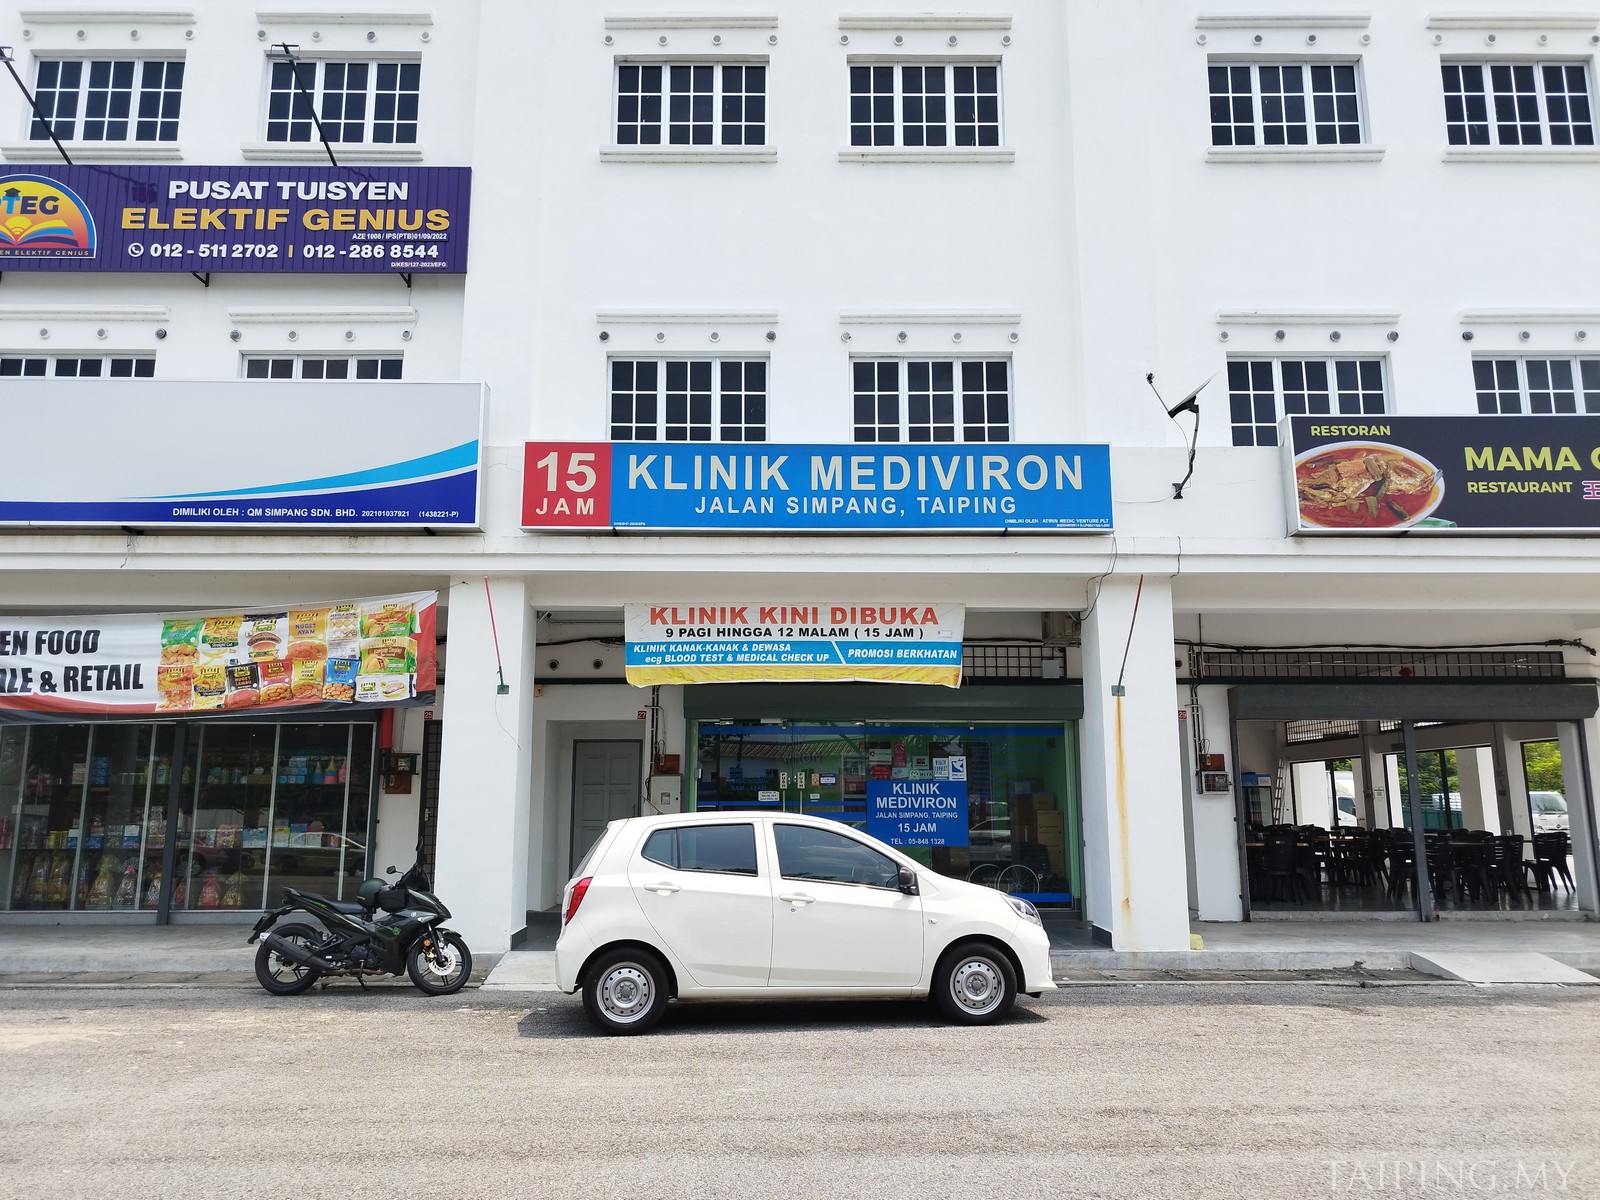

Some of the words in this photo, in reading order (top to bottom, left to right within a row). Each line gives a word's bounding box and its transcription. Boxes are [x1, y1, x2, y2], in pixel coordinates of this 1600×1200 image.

[168, 181, 268, 200] PUSAT
[277, 181, 409, 201] TUISYEN
[0, 195, 60, 215] TEG
[121, 207, 290, 230] ELEKTIF
[302, 208, 450, 231] GENIUS
[150, 244, 183, 258] 012
[198, 244, 227, 258] 511
[232, 244, 278, 258] 2702
[303, 245, 335, 258] 012
[349, 245, 385, 258] 286
[390, 245, 439, 258] 8544
[1310, 425, 1391, 436] RESTORAN
[1464, 446, 1582, 471] MAMA
[536, 451, 597, 493] 15
[628, 454, 790, 491] KLINIK
[811, 454, 1083, 491] MEDIVIRON
[1467, 481, 1573, 493] RESTAURANT
[172, 507, 210, 517] DIMILIKI
[212, 508, 239, 517] OLEH
[247, 508, 263, 518] QM
[265, 508, 308, 517] SIMPANG
[310, 508, 333, 517] SDN.
[335, 508, 358, 517] BHD.
[535, 497, 595, 515] JAM
[695, 496, 775, 514] JALAN
[786, 496, 905, 517] SIMPANG,
[917, 496, 1017, 514] TAIPING
[650, 606, 749, 625] KLINIK
[760, 606, 819, 625] KINI
[830, 606, 939, 625] DIBUKA
[665, 628, 674, 639] 9
[678, 628, 713, 638] PAGI
[717, 627, 772, 638] HINGGA
[777, 627, 794, 638] 12
[799, 627, 850, 638] MALAM
[864, 627, 880, 638] 15
[885, 627, 914, 638] JAM
[35, 629, 101, 655] FOOD
[633, 644, 667, 653] KLINIK
[669, 643, 740, 652] KANAK-KANAK
[742, 644, 750, 652] &
[752, 643, 791, 652] DEWASA
[645, 655, 662, 664] ecg
[664, 654, 698, 663] BLOOD
[700, 654, 725, 663] TEST
[726, 654, 735, 662] &
[736, 653, 778, 663] MEDICAL
[781, 653, 813, 662] CHECK
[818, 653, 830, 662] UP
[848, 648, 894, 658] PROMOSI
[896, 649, 957, 659] BERKHATAN
[40, 670, 57, 693] &
[64, 664, 144, 693] RETAIL
[425, 711, 433, 719] 25
[892, 783, 940, 795] KLINIK
[876, 797, 957, 809] MEDIVIRON
[898, 812, 930, 820] SIMPANG,
[898, 823, 910, 833] 15
[913, 823, 937, 833] JAM
